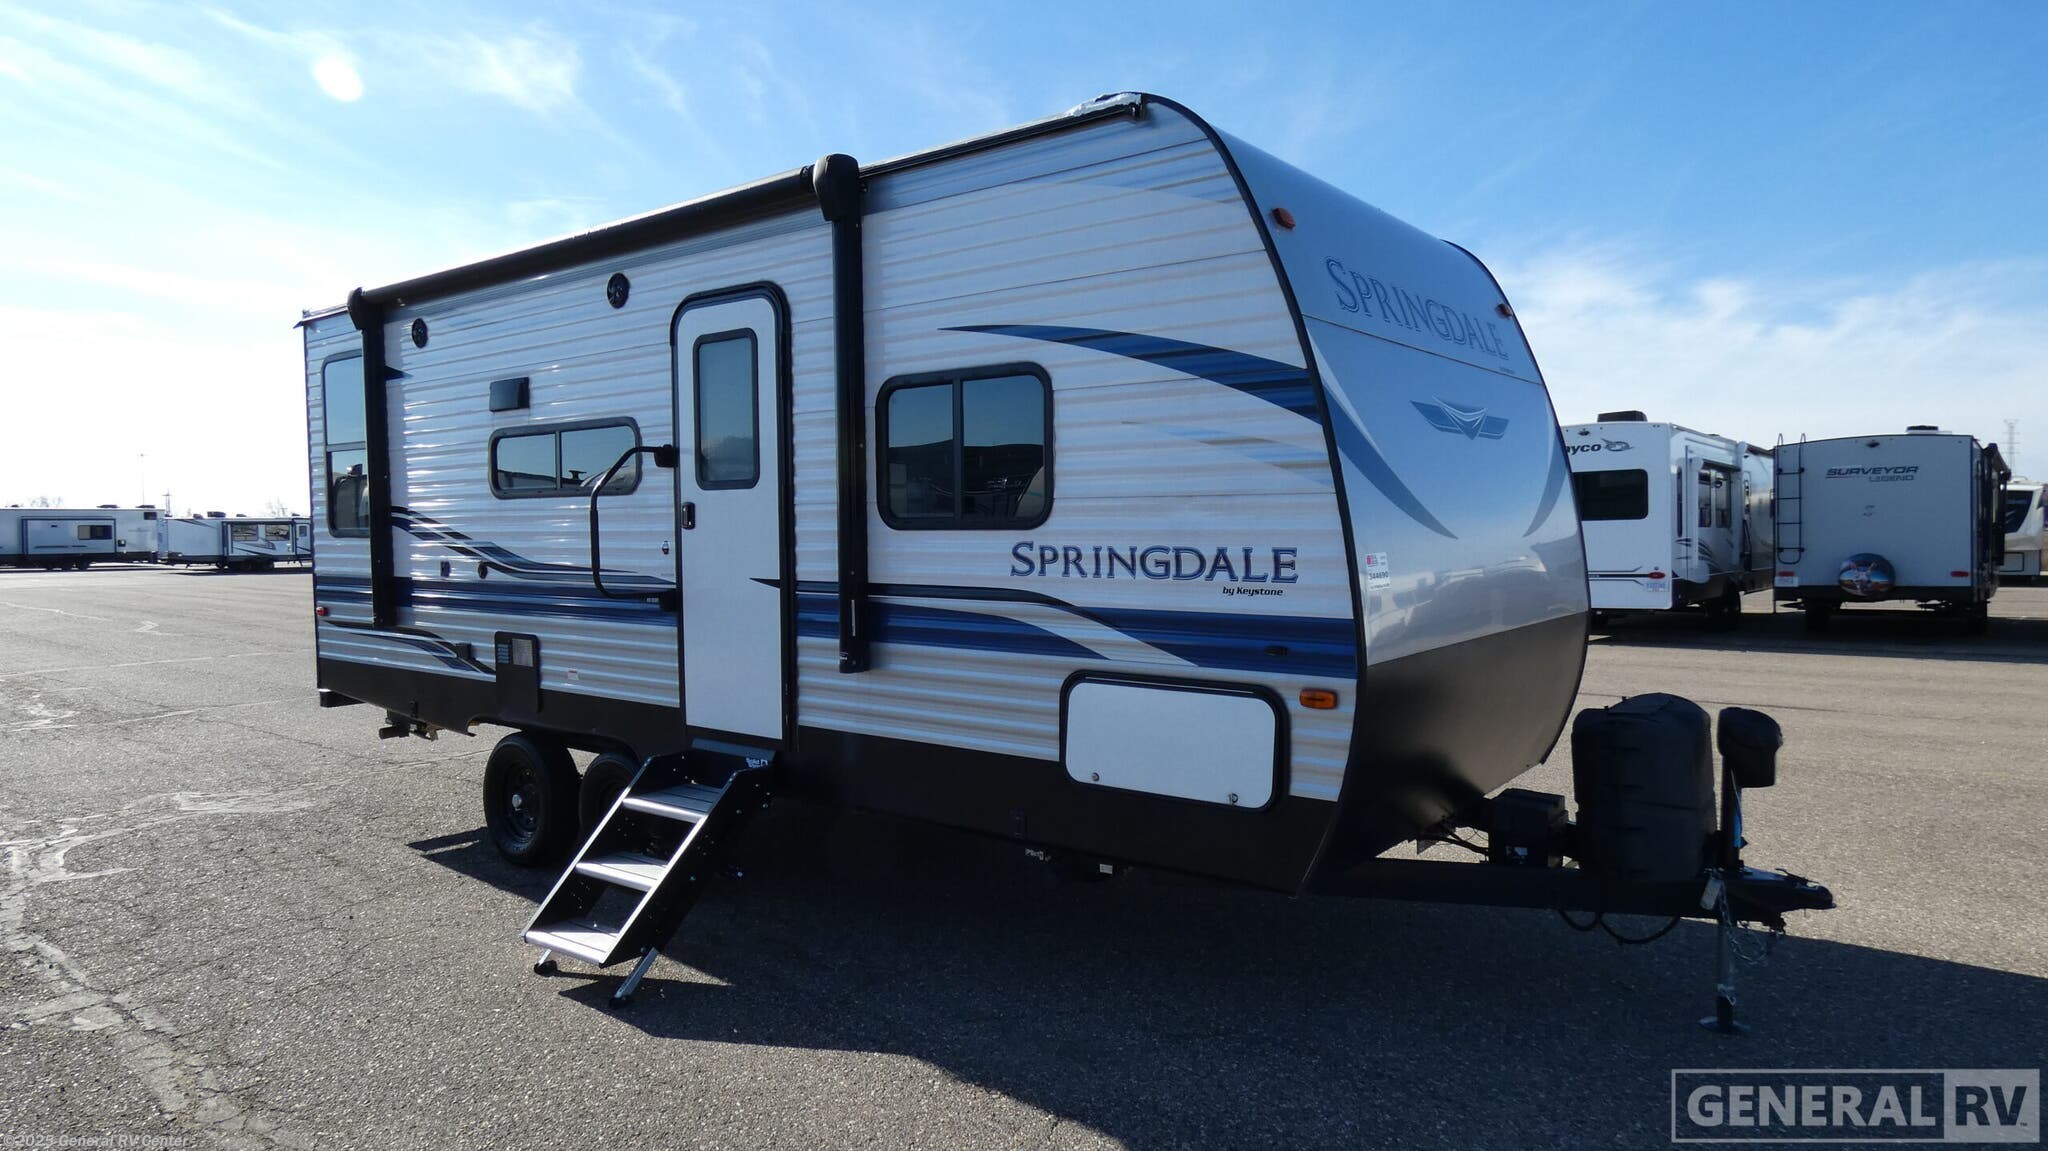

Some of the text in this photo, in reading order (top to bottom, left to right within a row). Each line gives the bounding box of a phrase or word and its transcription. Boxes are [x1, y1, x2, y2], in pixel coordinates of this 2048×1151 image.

[1566, 443, 1602, 455] yco
[1826, 466, 1919, 476] SURVEYOR
[1010, 541, 1299, 584] SPRINGDALE
[1222, 586, 1283, 597] by Keystone
